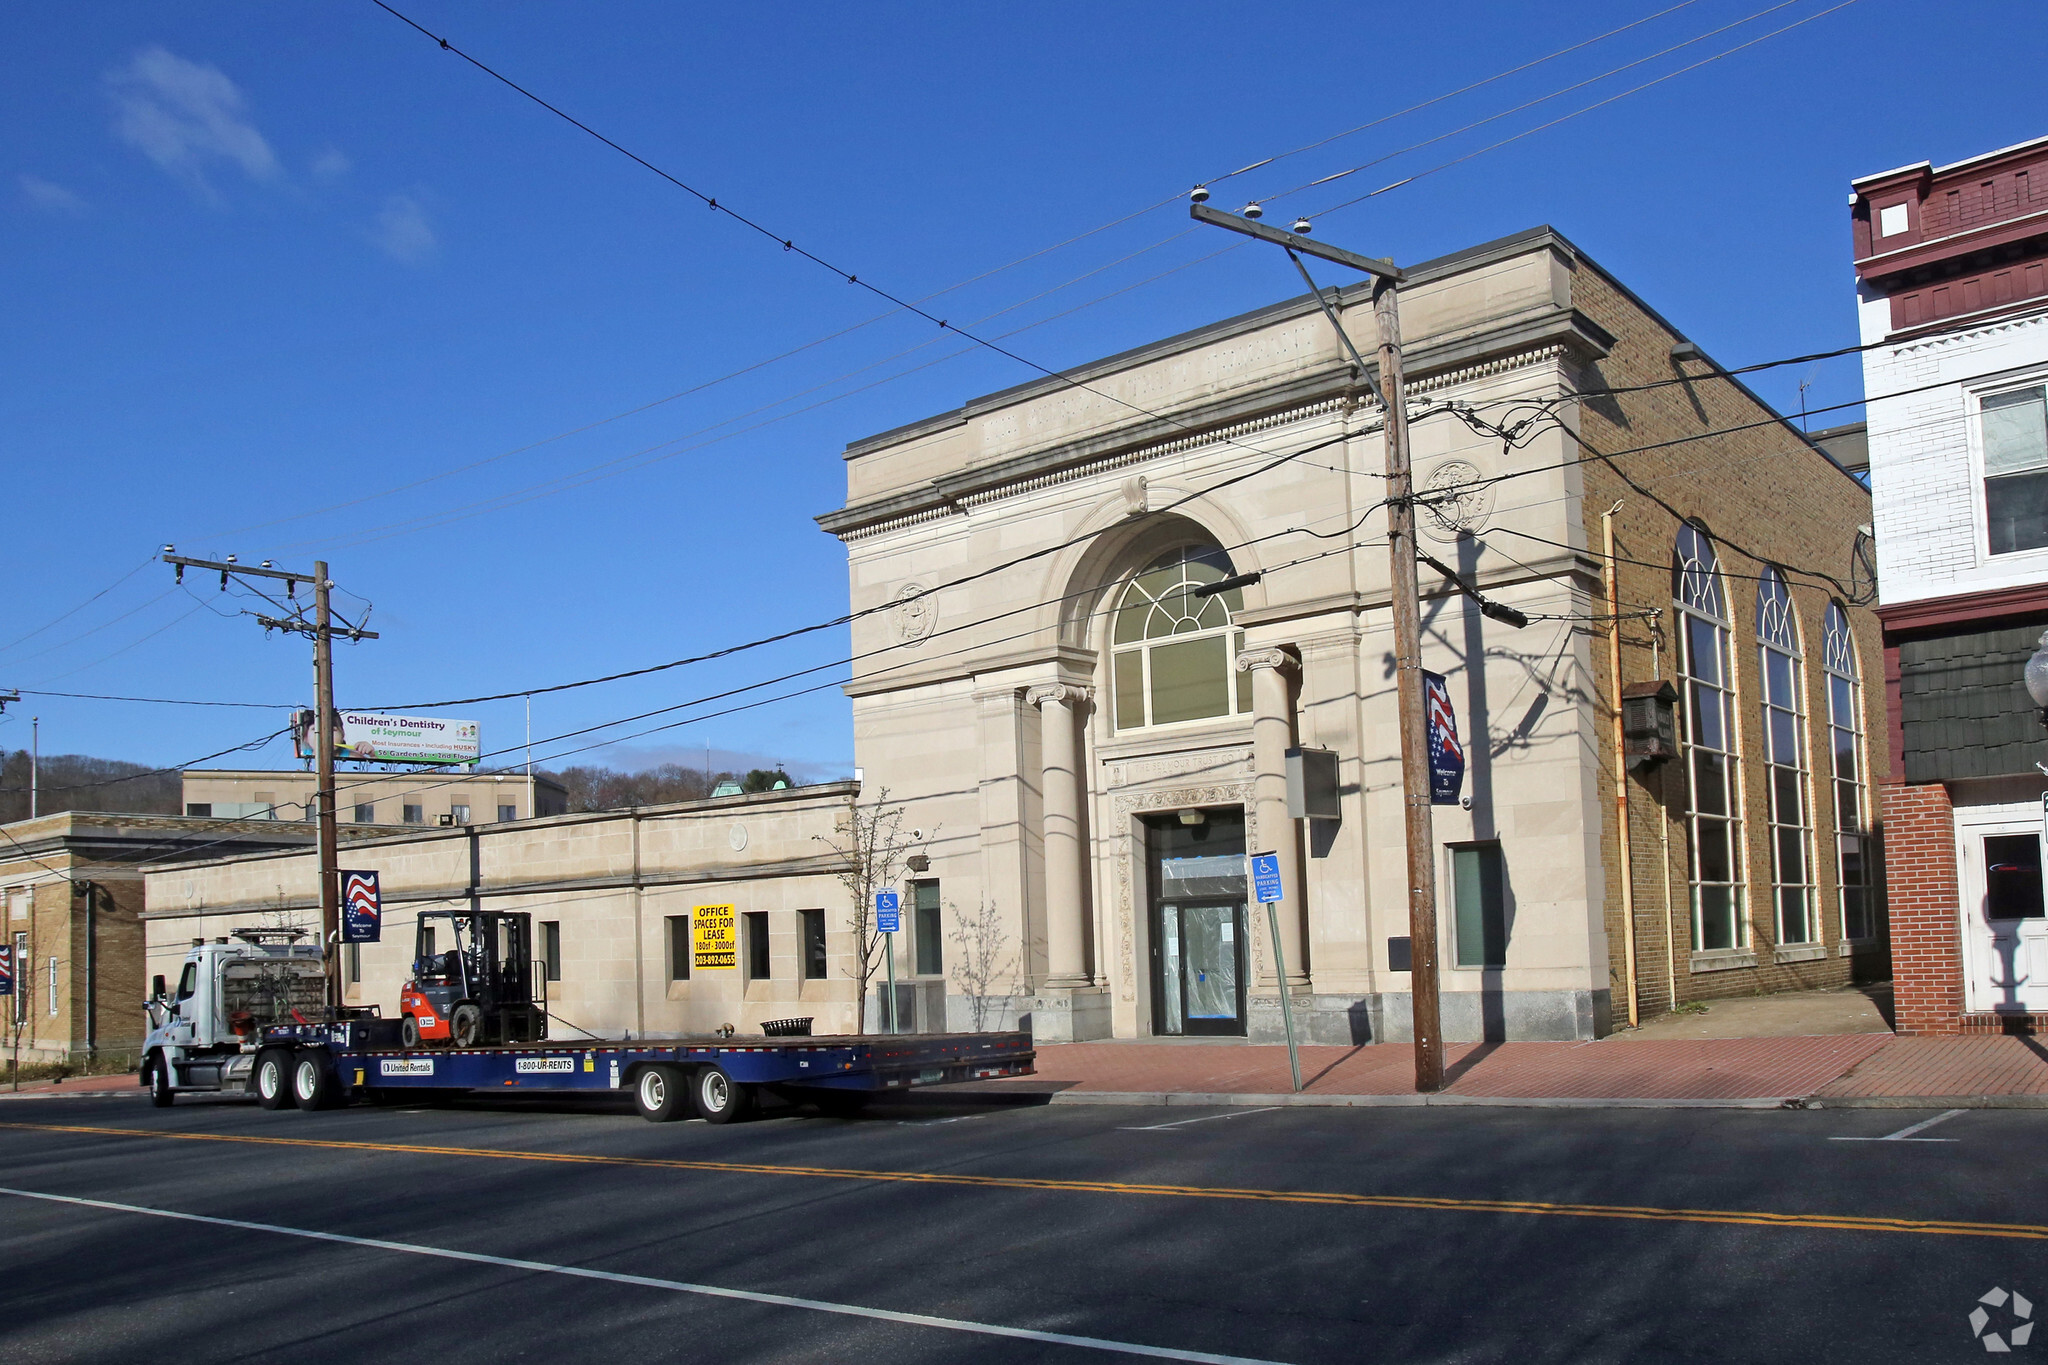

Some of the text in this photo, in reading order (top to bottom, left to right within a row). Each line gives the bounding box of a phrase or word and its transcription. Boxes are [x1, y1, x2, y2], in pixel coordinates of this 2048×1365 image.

[347, 715, 445, 731] Children's Dentistry
[371, 727, 422, 738] of Seymour
[1193, 755, 1218, 767] TRUST
[1256, 879, 1279, 887] PARKING
[699, 906, 729, 917] OFFICE
[694, 917, 734, 929] SPACES FOR
[703, 929, 725, 940] LEASE
[390, 1063, 431, 1072] United Rentals
[517, 1060, 572, 1070] 1-800-UR-RENTS
